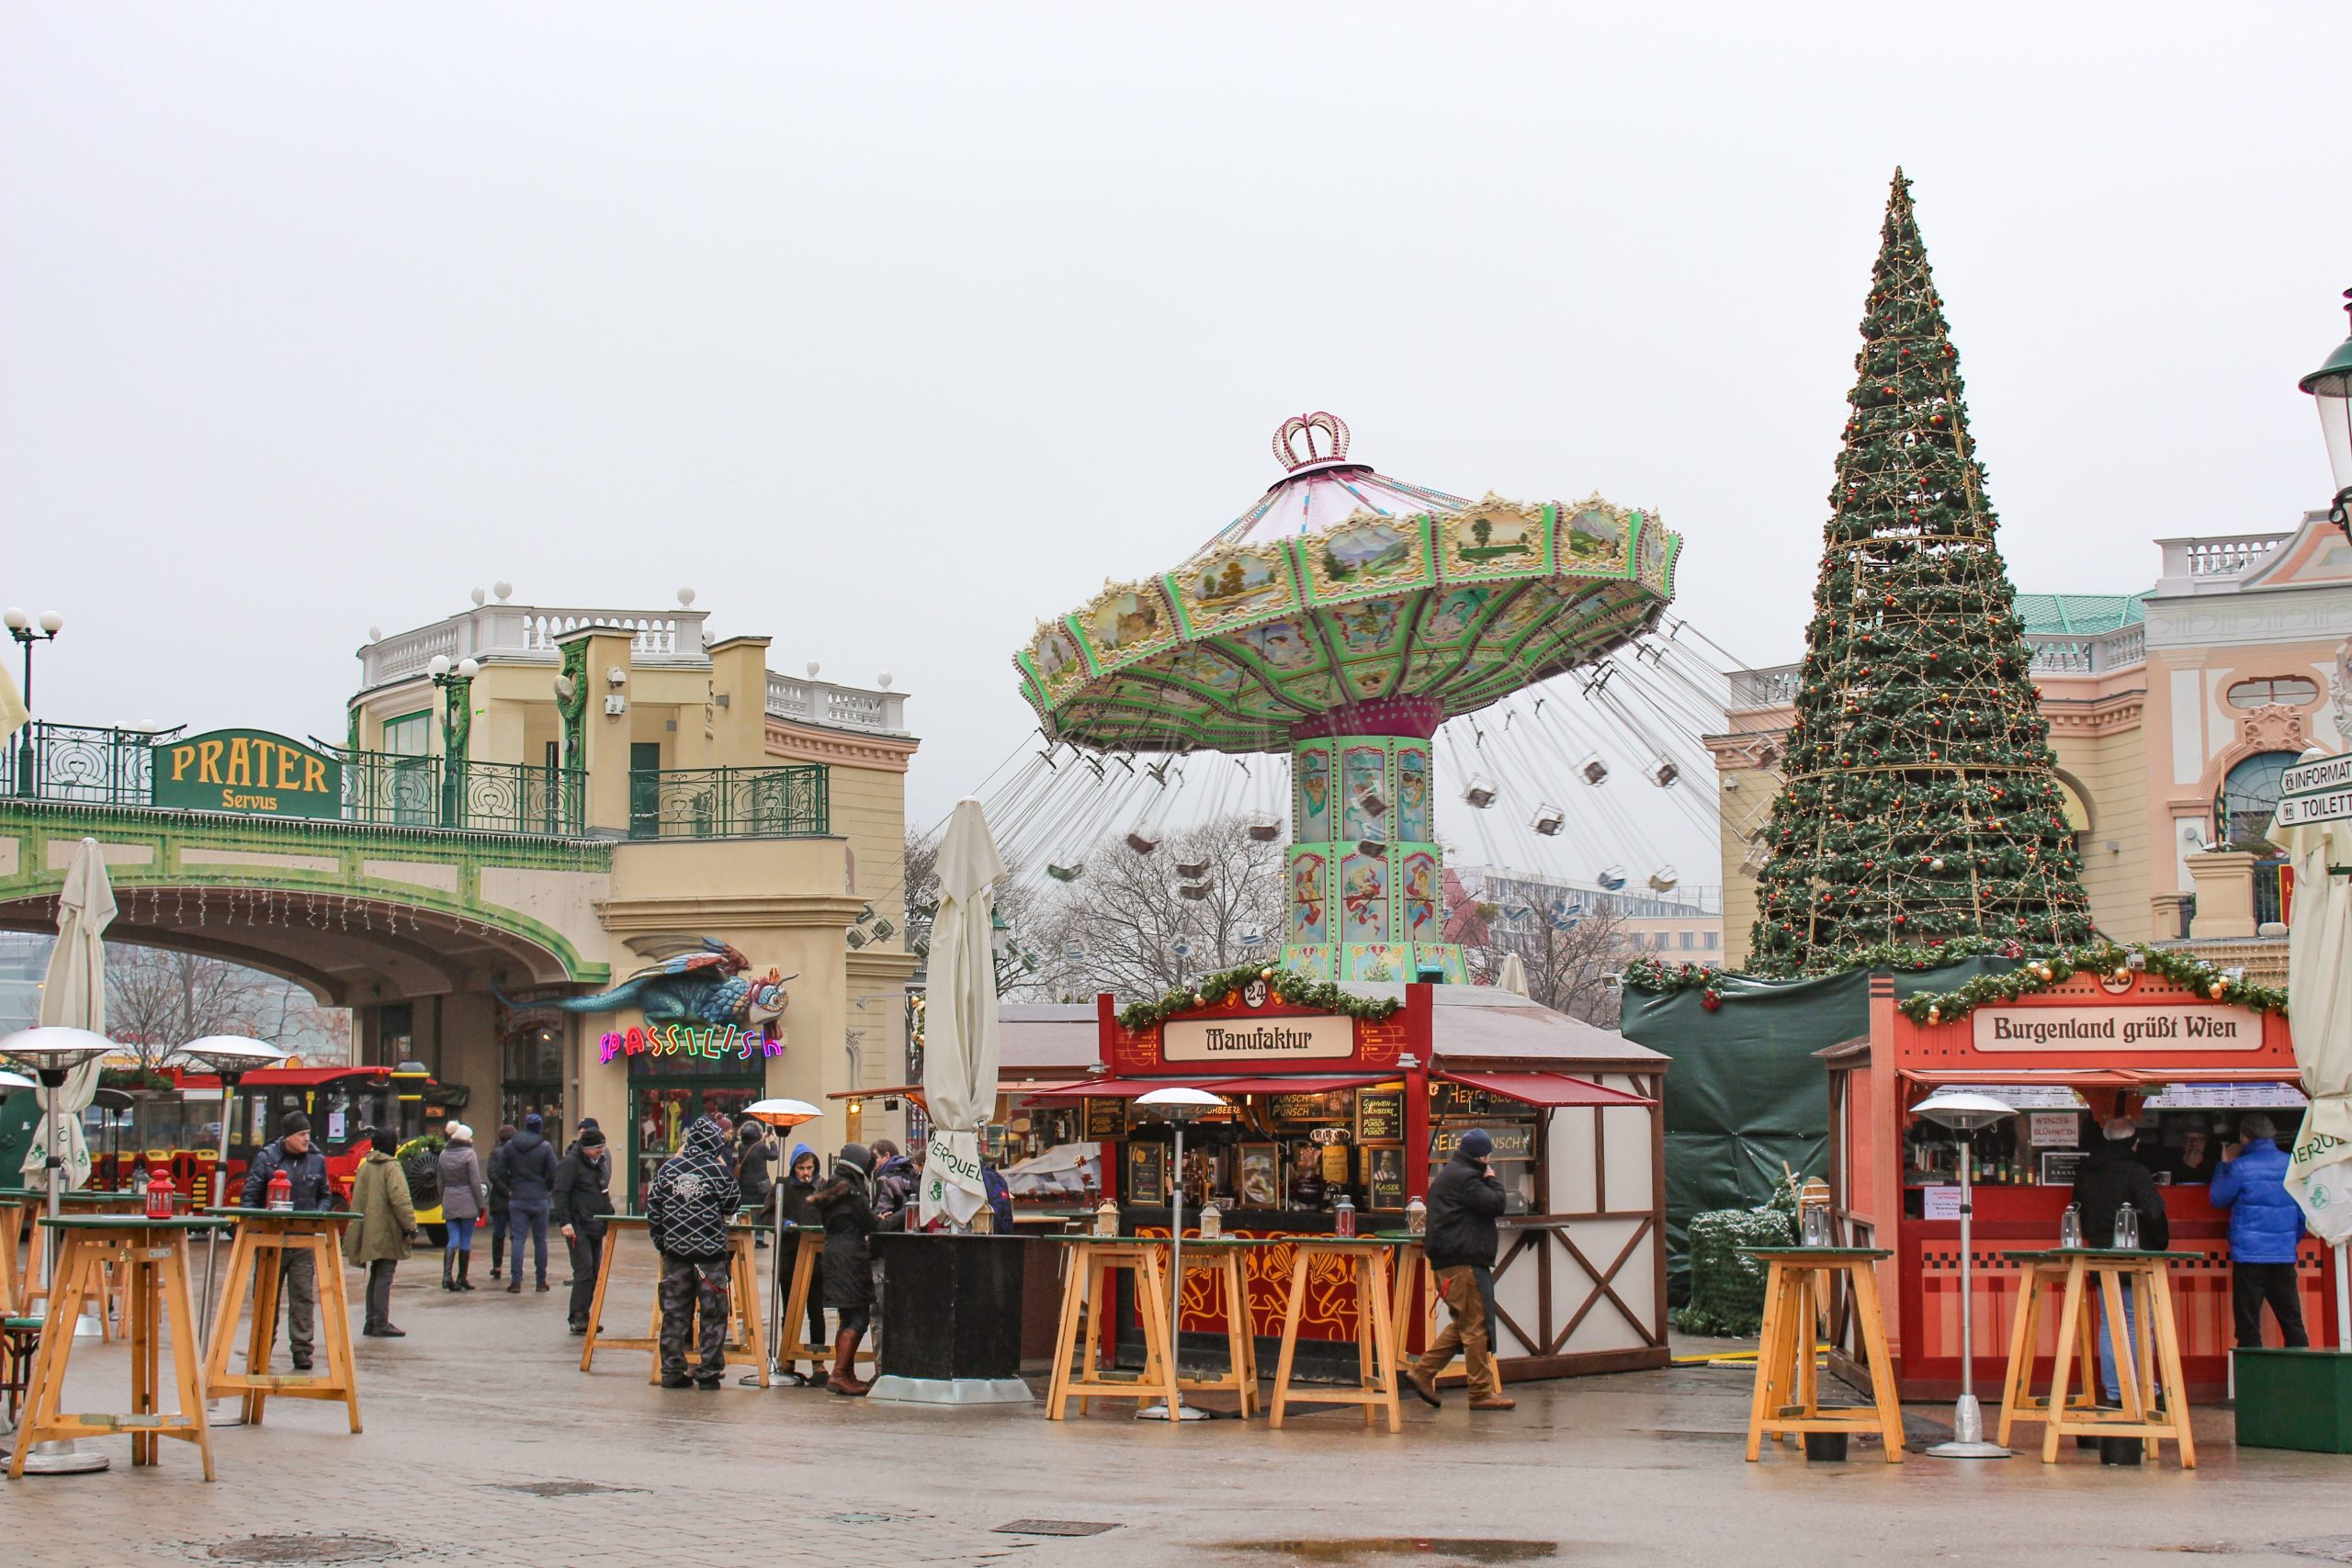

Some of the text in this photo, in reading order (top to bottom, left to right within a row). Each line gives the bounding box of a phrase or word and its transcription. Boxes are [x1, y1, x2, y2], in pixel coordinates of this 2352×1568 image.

[172, 738, 329, 793] PRATER
[2295, 761, 2351, 789] INFORMAT
[222, 789, 277, 811] Servus
[1247, 982, 1266, 1001] 24
[1206, 1027, 1312, 1051] Manufaktur
[1993, 1016, 2236, 1043] Burgenland grüßt Wien
[1272, 1105, 1309, 1117] PUNSCH
[1375, 1182, 1399, 1190] KAISER
